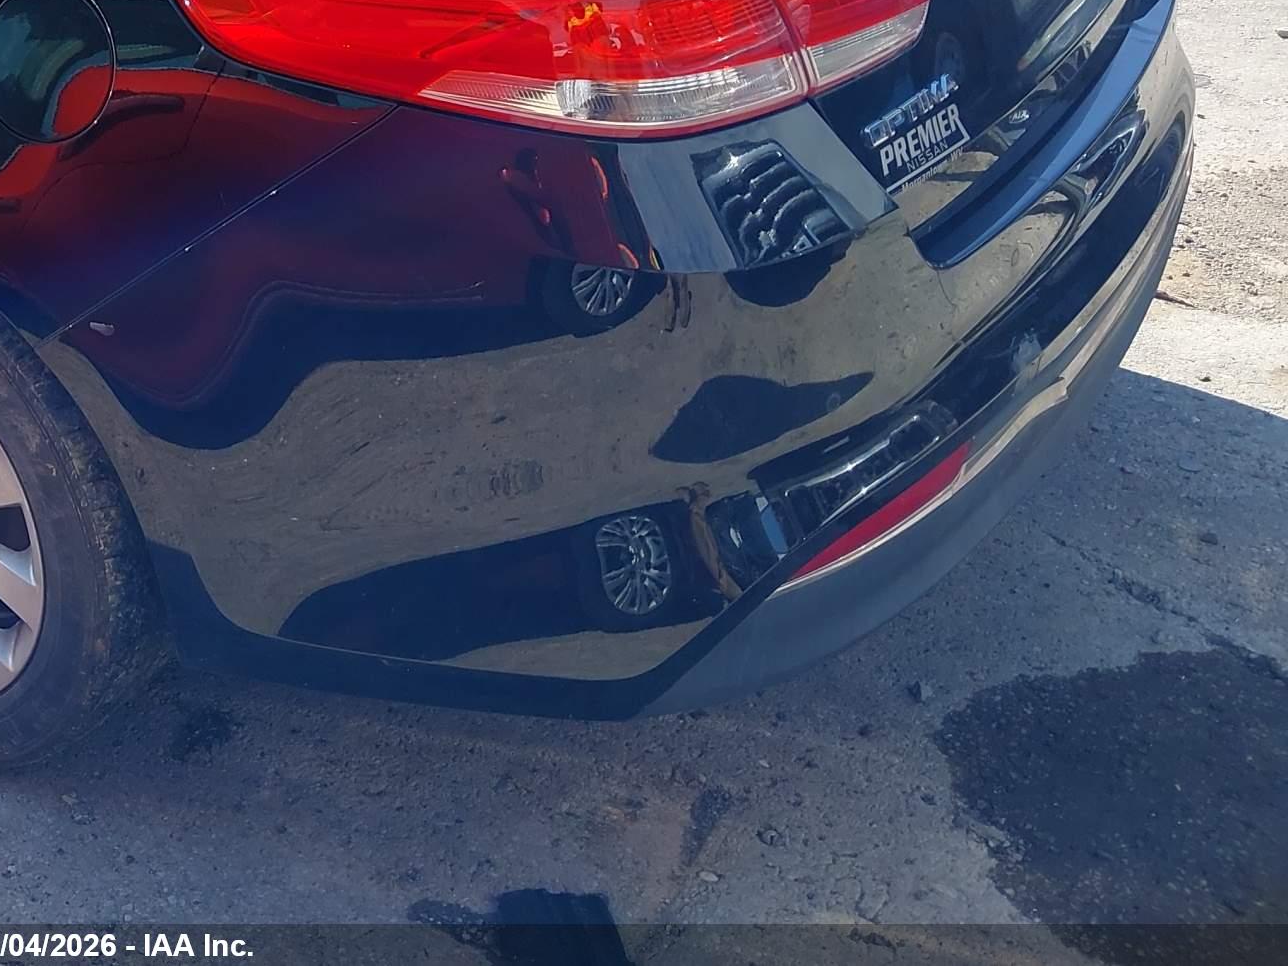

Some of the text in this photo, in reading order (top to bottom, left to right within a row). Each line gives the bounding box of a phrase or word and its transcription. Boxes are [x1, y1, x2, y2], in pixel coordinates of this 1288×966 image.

[864, 73, 959, 147] OPTIMA
[879, 103, 960, 177] PREMIER
[906, 139, 948, 172] NISSAN
